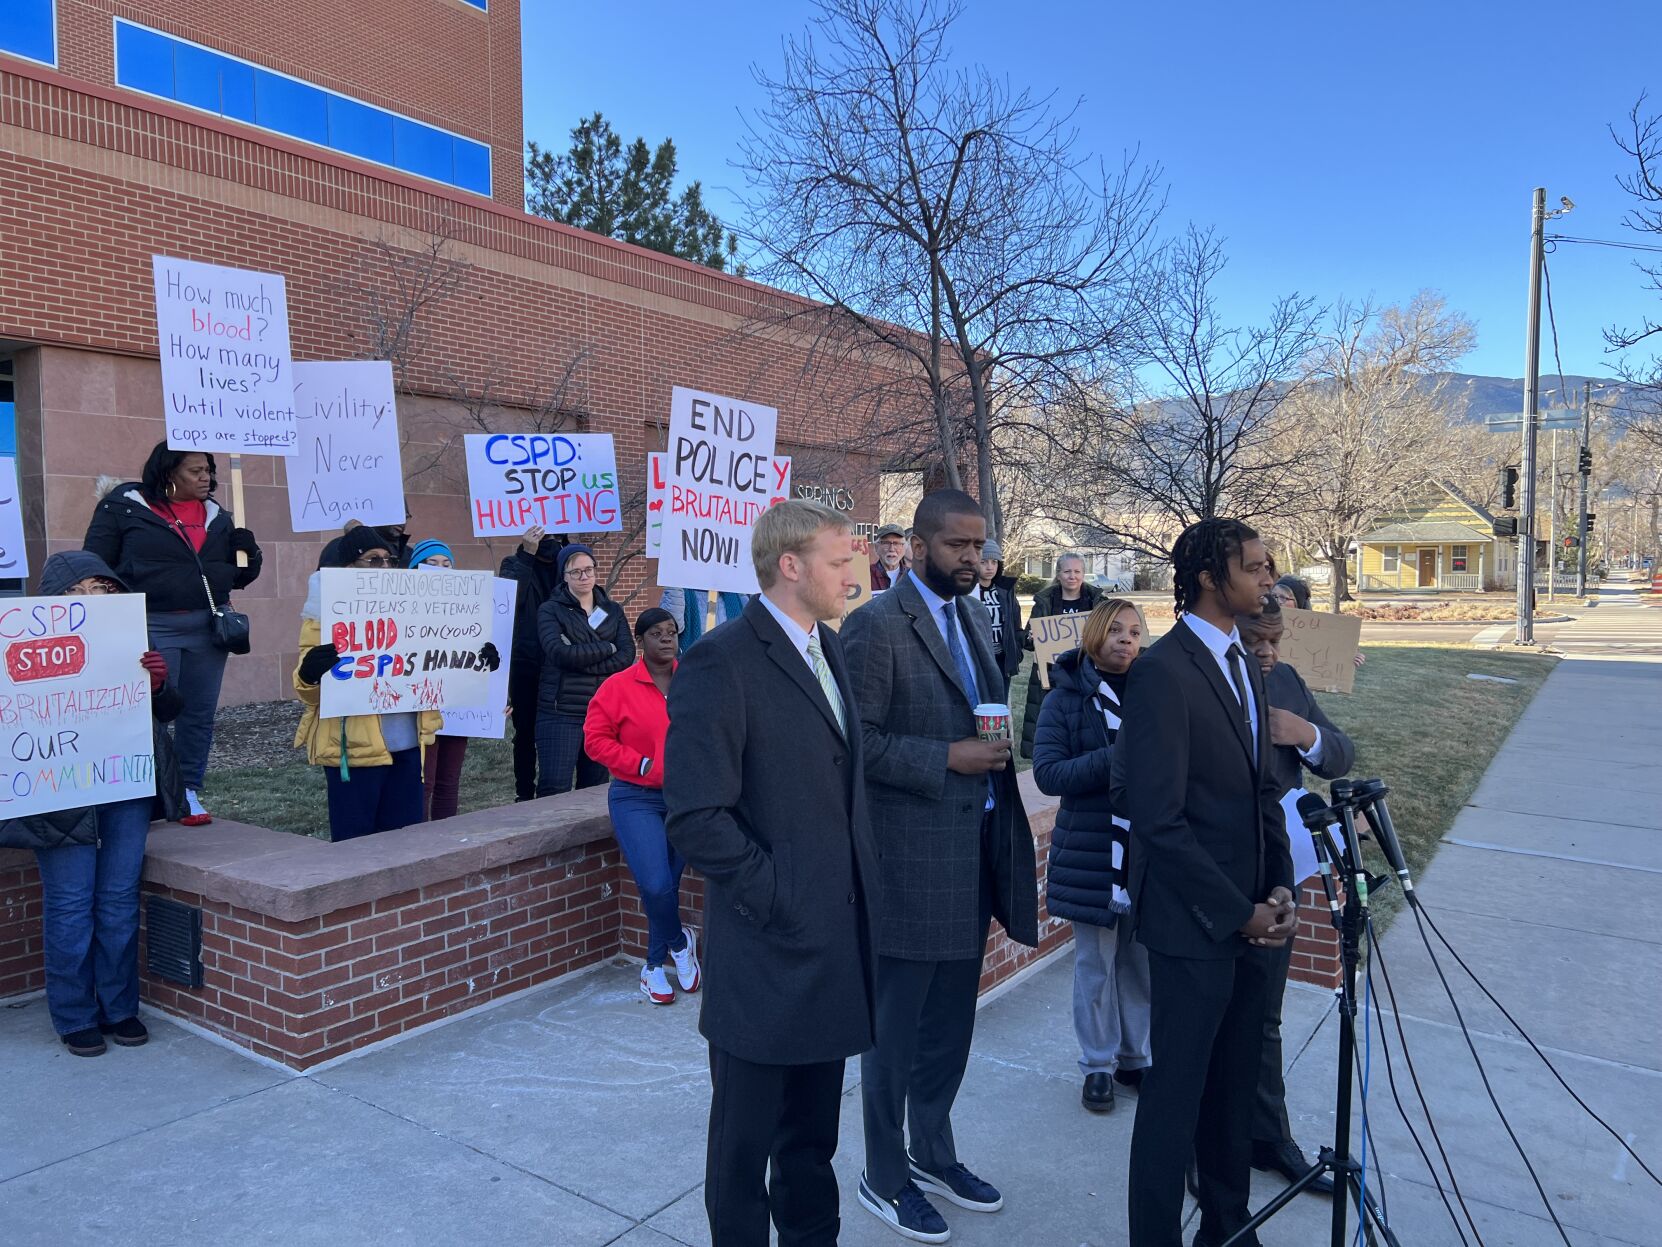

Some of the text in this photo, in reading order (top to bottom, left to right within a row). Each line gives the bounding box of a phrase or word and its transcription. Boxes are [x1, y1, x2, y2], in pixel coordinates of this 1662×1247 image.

[166, 269, 273, 315] How much
[170, 334, 280, 383] How many
[200, 367, 261, 393] lives?
[172, 393, 295, 421] Until violent
[691, 399, 755, 442] END
[215, 431, 237, 441] are
[244, 429, 297, 447] stopped?
[316, 433, 384, 474] Never
[485, 434, 582, 466] CSPD:
[504, 468, 577, 494] STOP
[675, 436, 768, 494] POLICE
[302, 481, 374, 521] Again
[475, 489, 617, 530] HURTING
[672, 485, 766, 526] BRUTALITY
[797, 485, 855, 511] SPRINGS
[681, 528, 739, 568] NOW!
[356, 571, 486, 597] INNOCENT
[0, 602, 86, 638] CSPD
[411, 601, 418, 614] &
[332, 617, 398, 654] BLOOD
[404, 625, 417, 639] IS
[17, 645, 77, 671] STOP
[0, 681, 147, 724] BRUTALIZING
[11, 730, 79, 761] OUR
